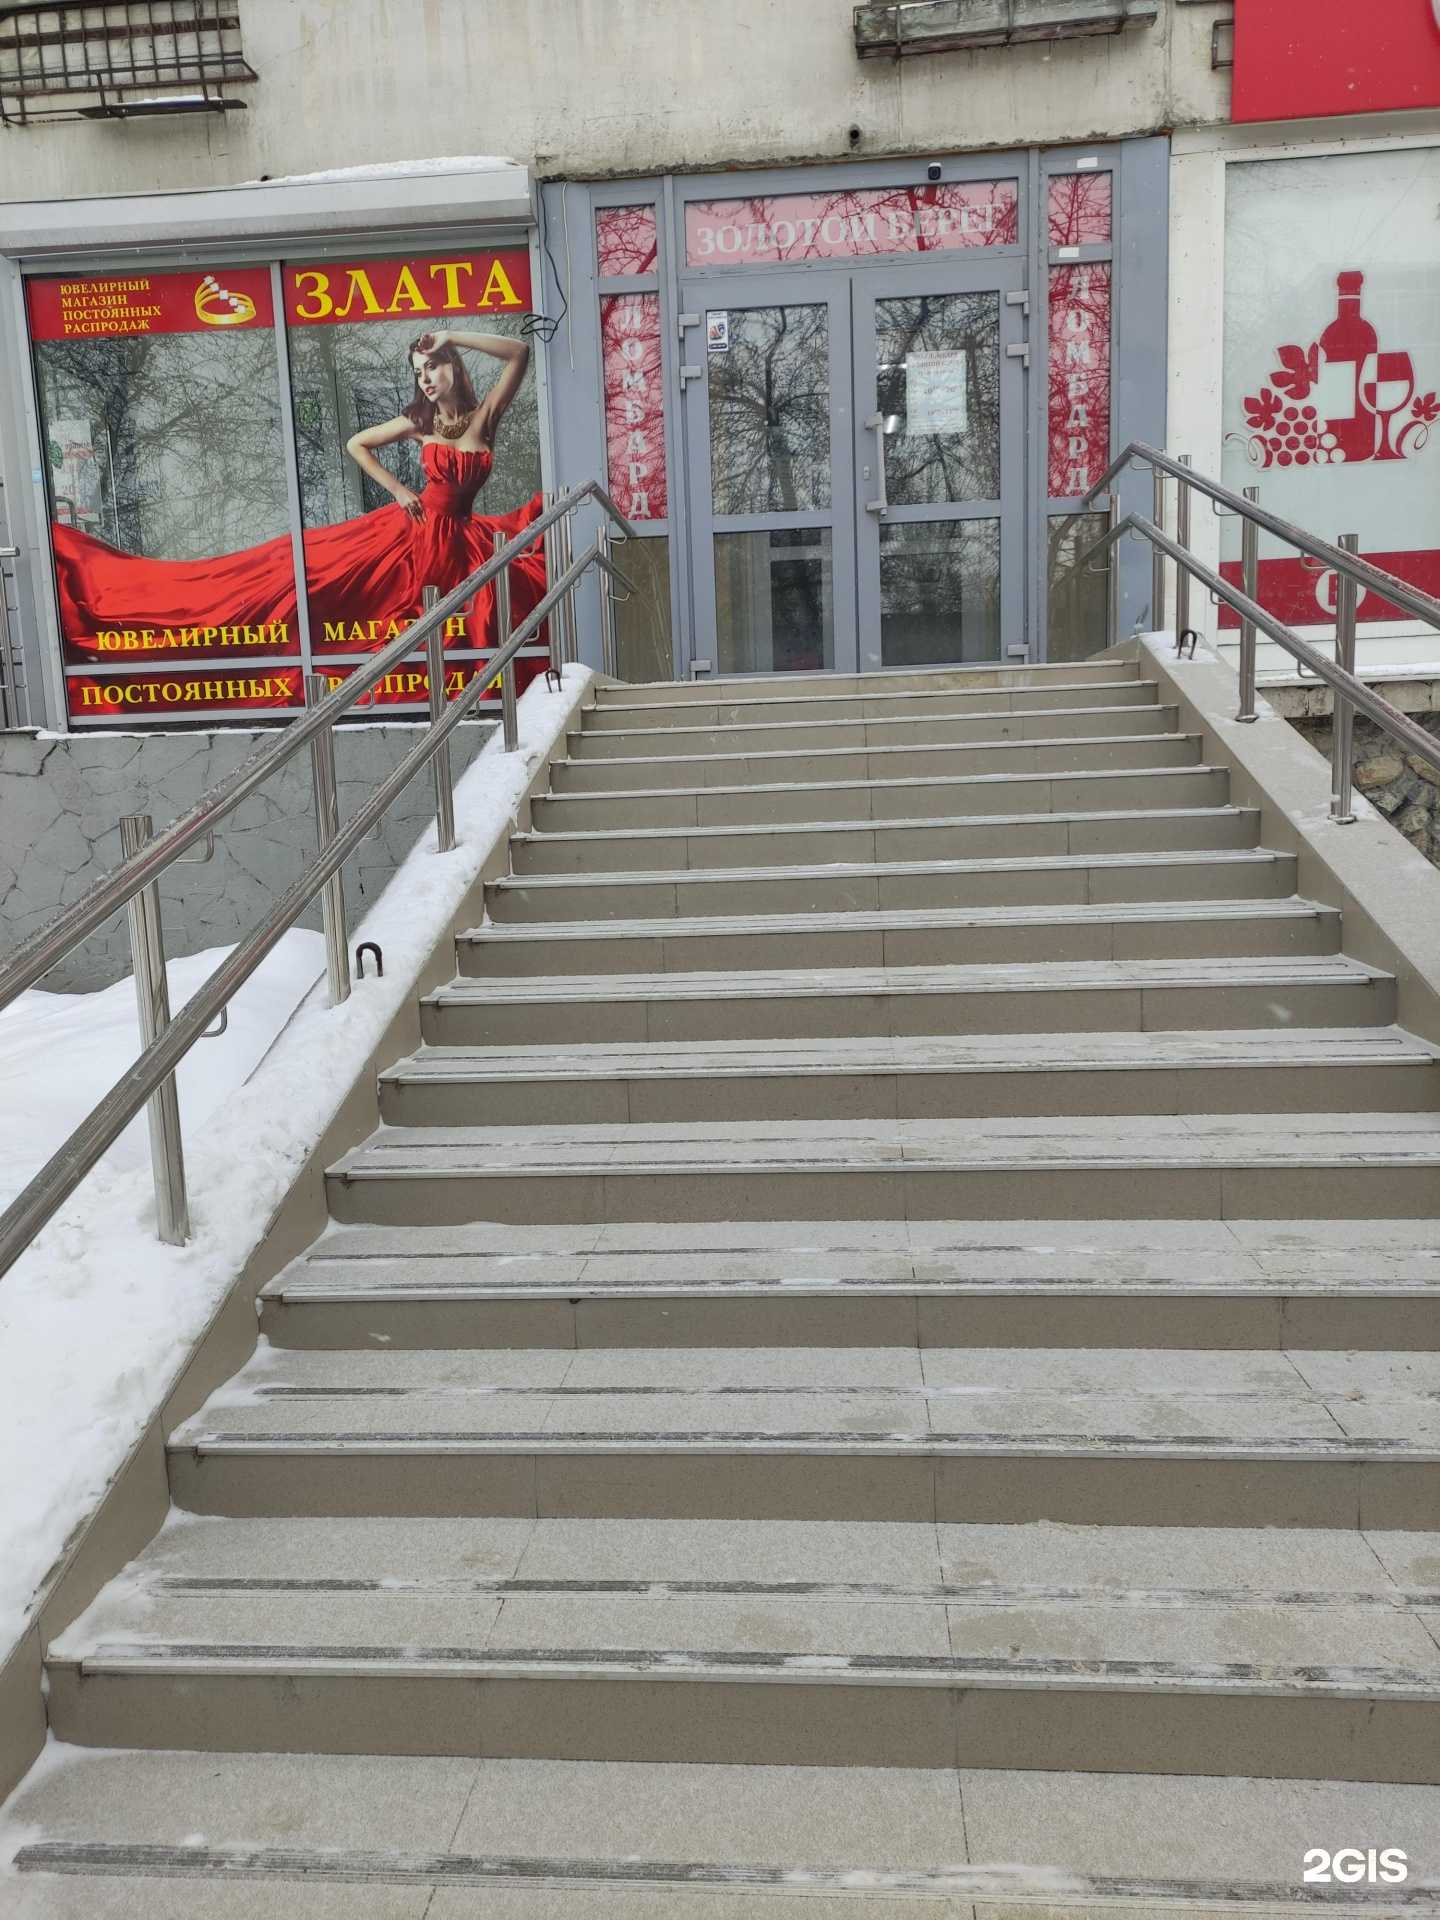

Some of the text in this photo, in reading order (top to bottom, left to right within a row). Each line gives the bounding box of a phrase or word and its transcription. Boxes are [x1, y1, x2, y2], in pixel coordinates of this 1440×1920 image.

[696, 203, 1004, 255] ЗОЛОТОЙ БЕРЕГ
[60, 279, 151, 295] ЮВЕЛИРНЫЙ
[62, 294, 129, 308] МАГАЗИН
[295, 259, 523, 319] ЗЛАТА
[63, 305, 162, 321] ПОСТОЯННЫХ
[64, 319, 151, 334] РАСПРОДАЖ
[1066, 276, 1090, 496] ЛОМБАРД
[621, 304, 651, 520] ЛОМБАРД
[95, 615, 467, 651] ЮВЕЛИРНЫЙ МАГАН
[81, 677, 294, 706] ПОСТОЯННЫХ
